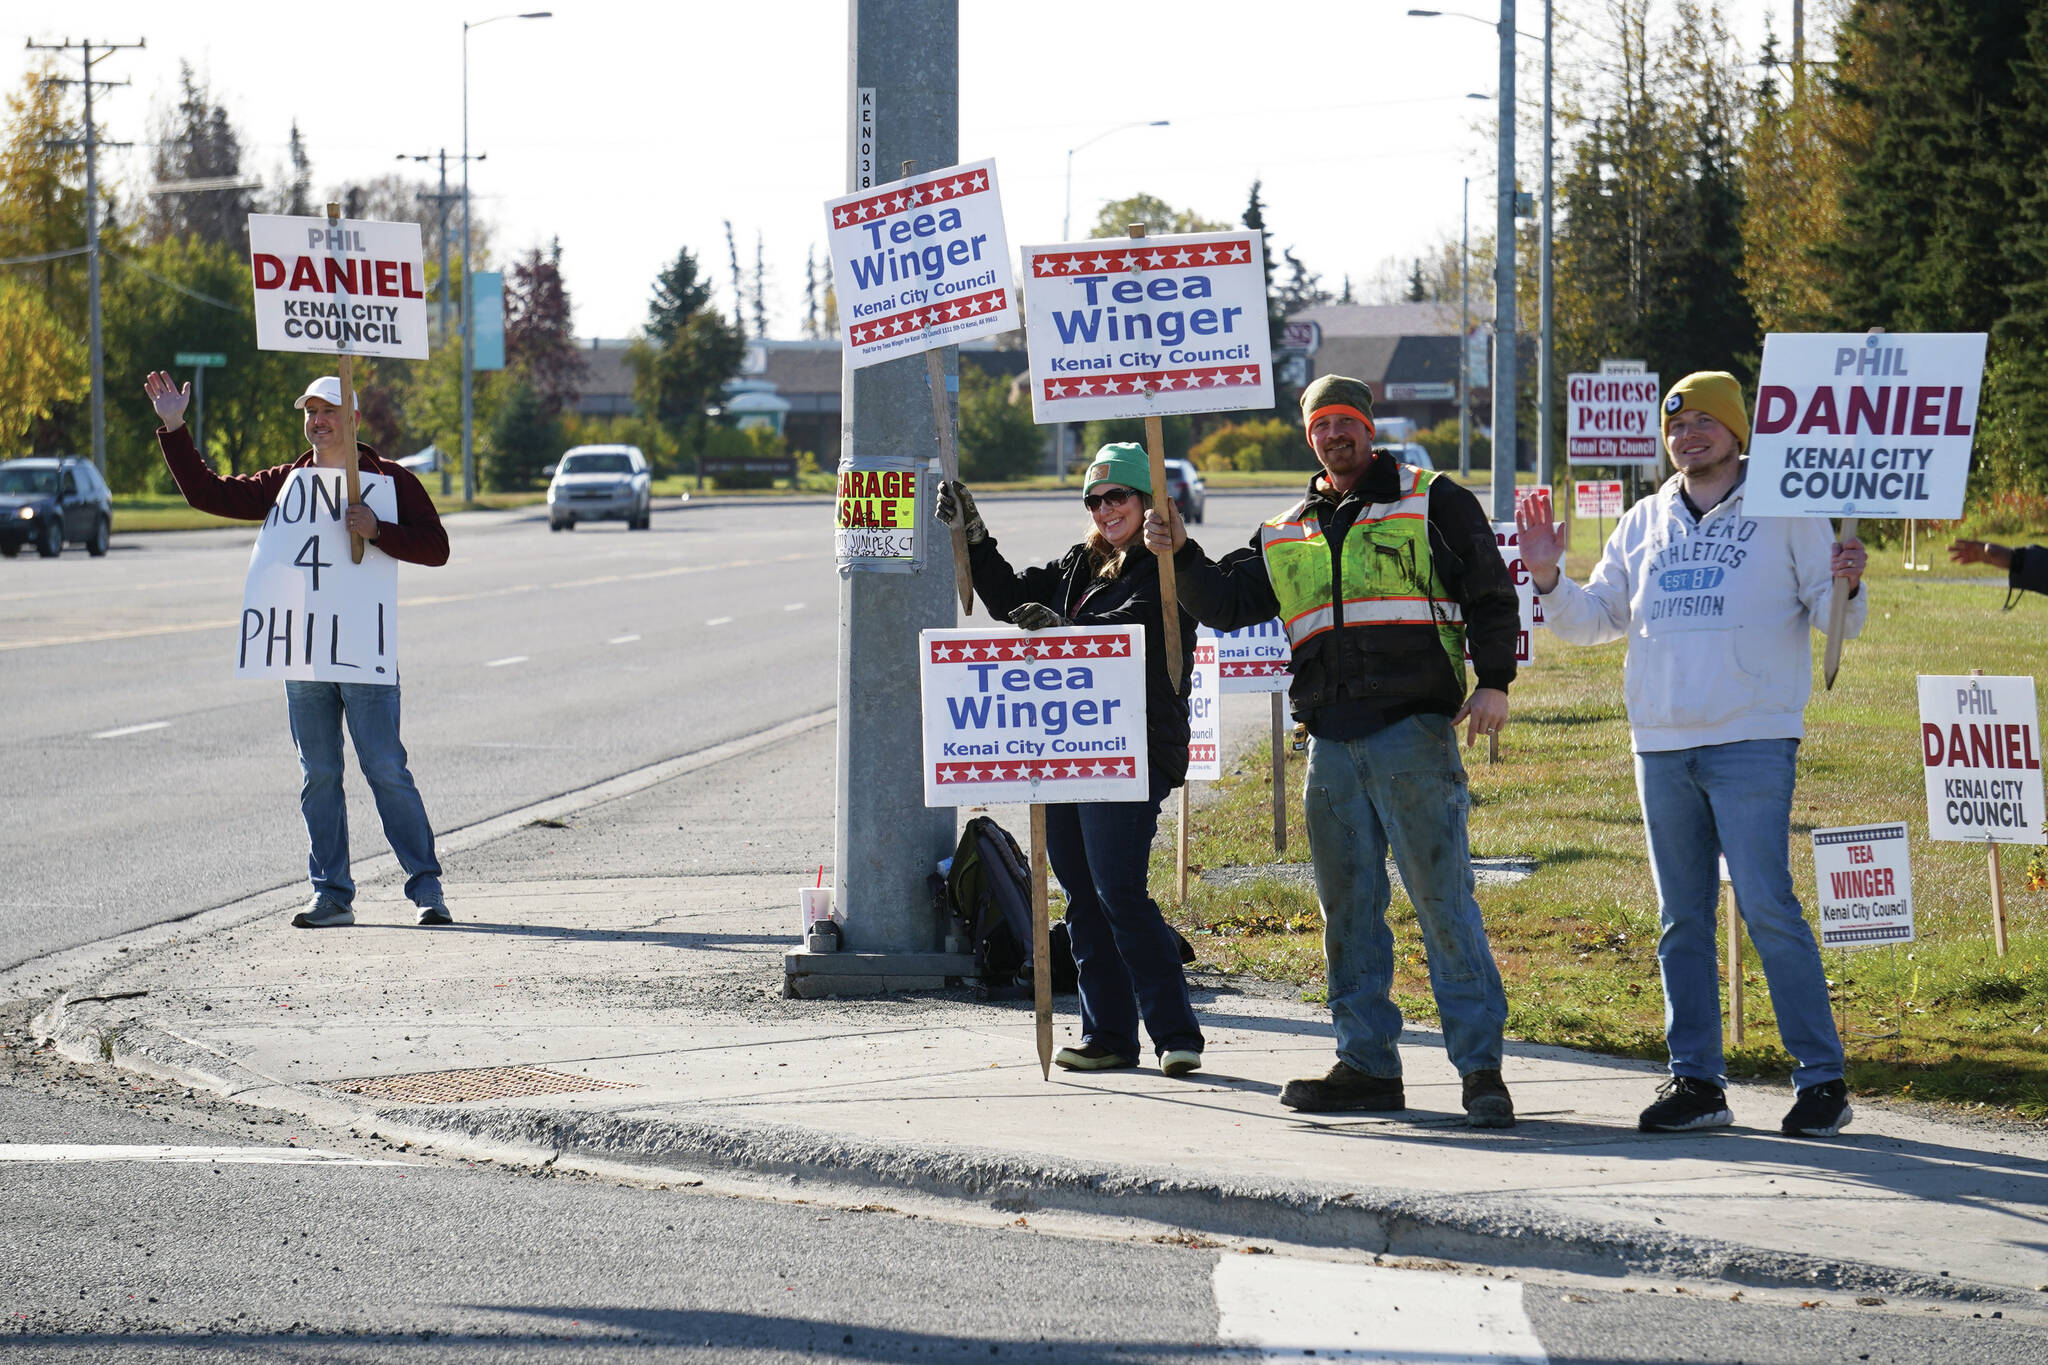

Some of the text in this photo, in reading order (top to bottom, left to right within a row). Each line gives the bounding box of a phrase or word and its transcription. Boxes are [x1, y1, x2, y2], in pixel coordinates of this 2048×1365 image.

[308, 228, 366, 252] PHIL
[863, 208, 962, 250] Teea
[850, 234, 988, 290] Winger
[254, 254, 424, 299] DANIEL
[852, 270, 996, 318] Kenai City Council
[1074, 275, 1212, 306] Teea
[284, 300, 398, 322] KENAI CITY
[284, 318, 402, 344] COUNCIL
[1052, 306, 1242, 346] Winger
[1052, 354, 1112, 372] Kenai
[1119, 352, 1162, 368] City
[1834, 348, 1908, 376] PHIL
[1570, 378, 1657, 403] Glenese
[1578, 407, 1648, 434] Pettey
[1755, 386, 1972, 436] DANIEL
[1600, 440, 1618, 456] City
[1620, 440, 1654, 456] Council
[1784, 448, 1934, 470] KENAI CITY
[1780, 472, 1930, 500] COUNCIL
[843, 500, 897, 528] SALE
[294, 535, 333, 591] 4
[1664, 568, 1718, 588] EST 87
[1652, 595, 1724, 620] DIVISION
[1218, 646, 1284, 658] enai City
[968, 664, 1093, 692] Teea
[947, 694, 1121, 736] Winger
[1956, 688, 1998, 715] PHIL
[1192, 728, 1213, 739] ouncil
[1922, 722, 2040, 770] DANIEL
[943, 741, 999, 756] Kenai
[1006, 740, 1045, 757] City
[1945, 779, 2023, 800] KENAI CITY
[1946, 800, 2028, 828] COUNCIL
[1847, 845, 1874, 864] TEEA
[1830, 868, 1896, 900] WINGER
[1823, 900, 1907, 920] Kenai City Council
